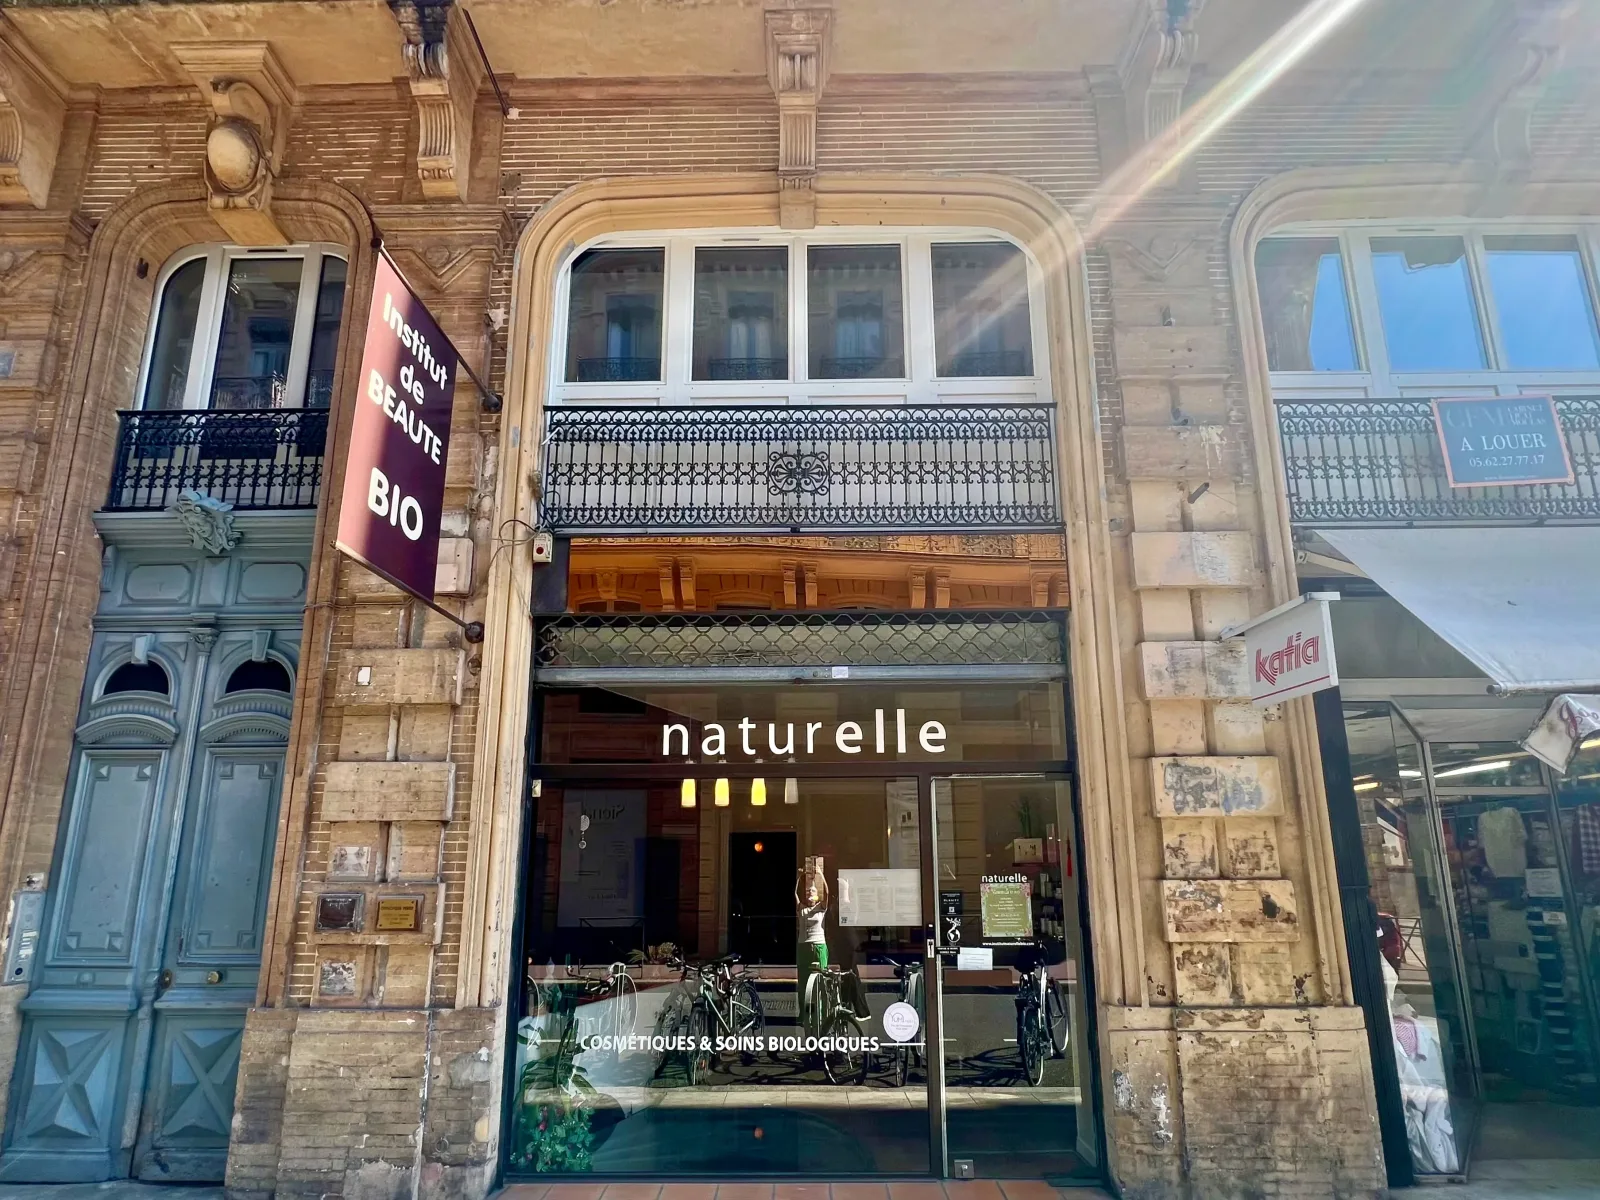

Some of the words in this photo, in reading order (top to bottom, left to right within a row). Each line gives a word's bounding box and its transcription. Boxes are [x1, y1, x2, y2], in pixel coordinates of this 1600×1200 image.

[383, 293, 448, 390] Institut
[400, 365, 425, 405] de
[367, 368, 442, 465] BEAUTE
[1461, 437, 1474, 451] A
[1482, 433, 1547, 451] LOUER
[1469, 454, 1545, 467] 05.62.27.77.17
[367, 467, 424, 541] BIO
[1255, 631, 1320, 687] katia
[662, 708, 947, 756] naturelle
[981, 873, 1028, 883] naturelle
[580, 1033, 697, 1053] COSMÉTIQUES
[699, 1036, 714, 1052] &
[716, 1036, 764, 1052] SOINS
[768, 1035, 880, 1053] BIOLOGIQUES
